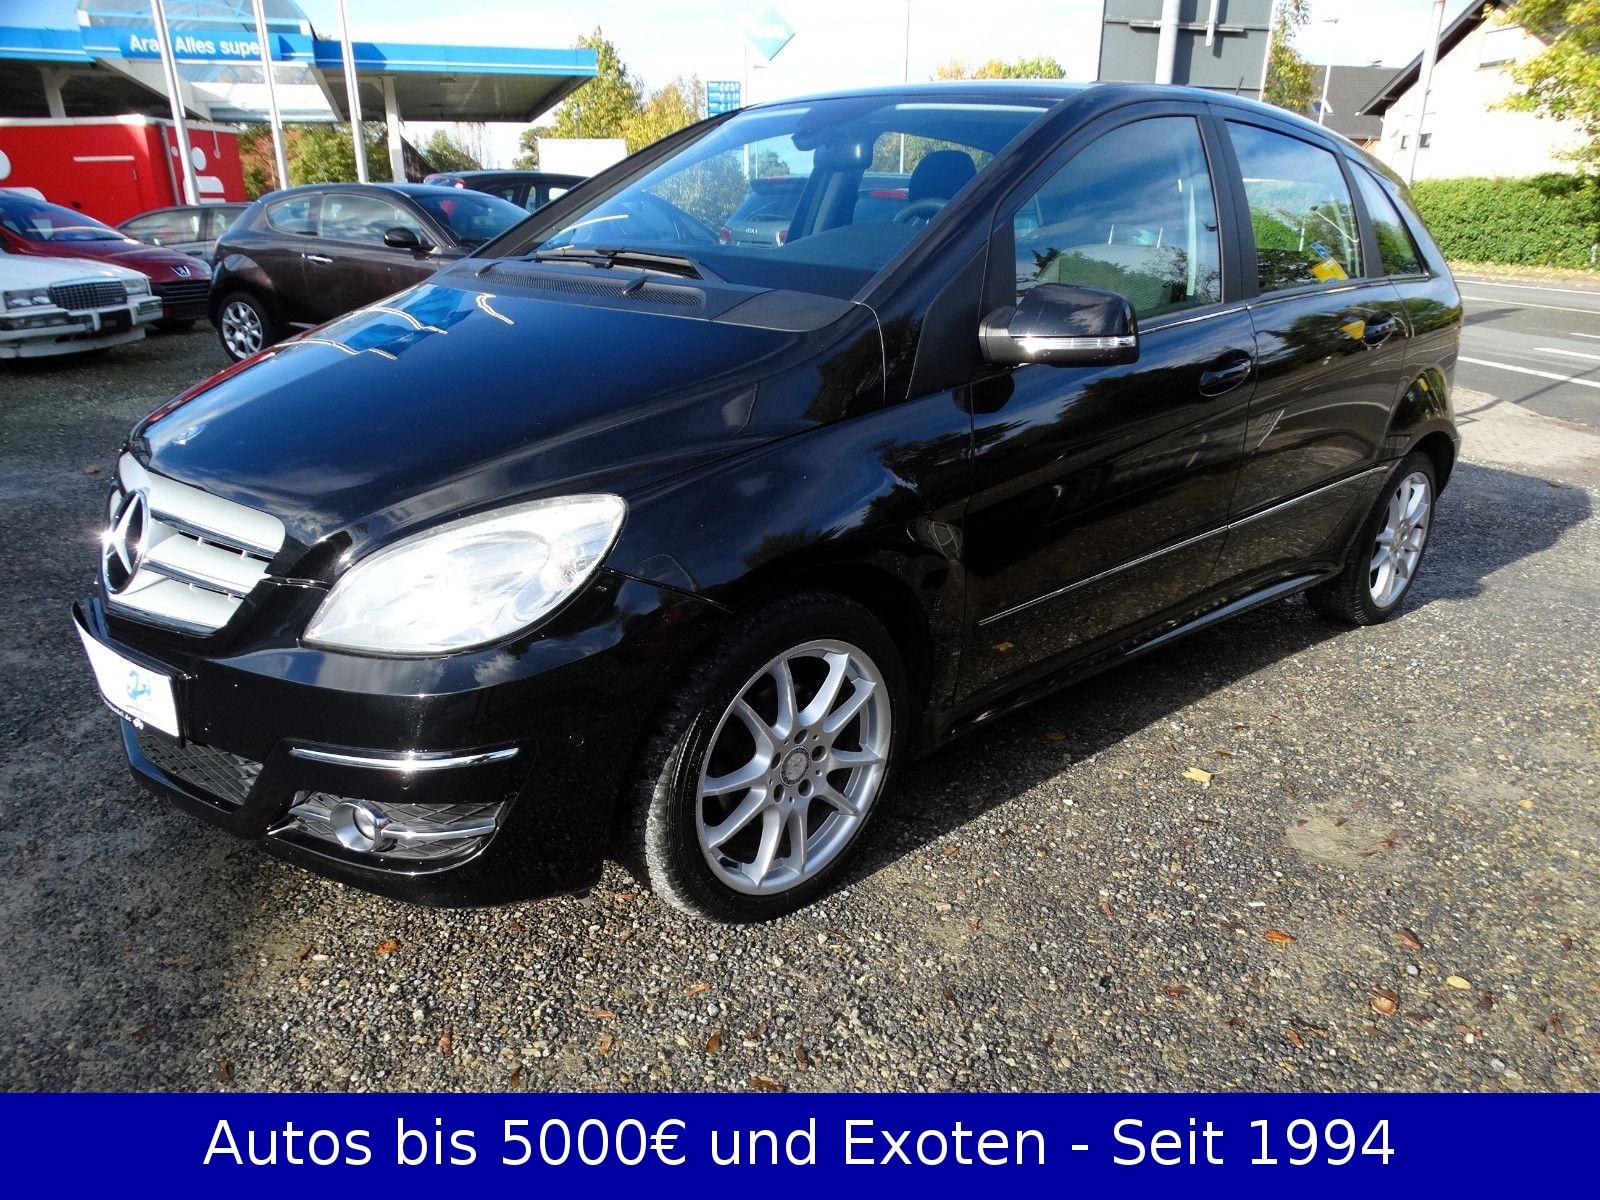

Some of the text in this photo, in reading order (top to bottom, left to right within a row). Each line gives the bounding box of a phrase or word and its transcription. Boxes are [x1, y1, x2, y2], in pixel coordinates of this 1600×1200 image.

[130, 34, 262, 59] Ara Alles supe
